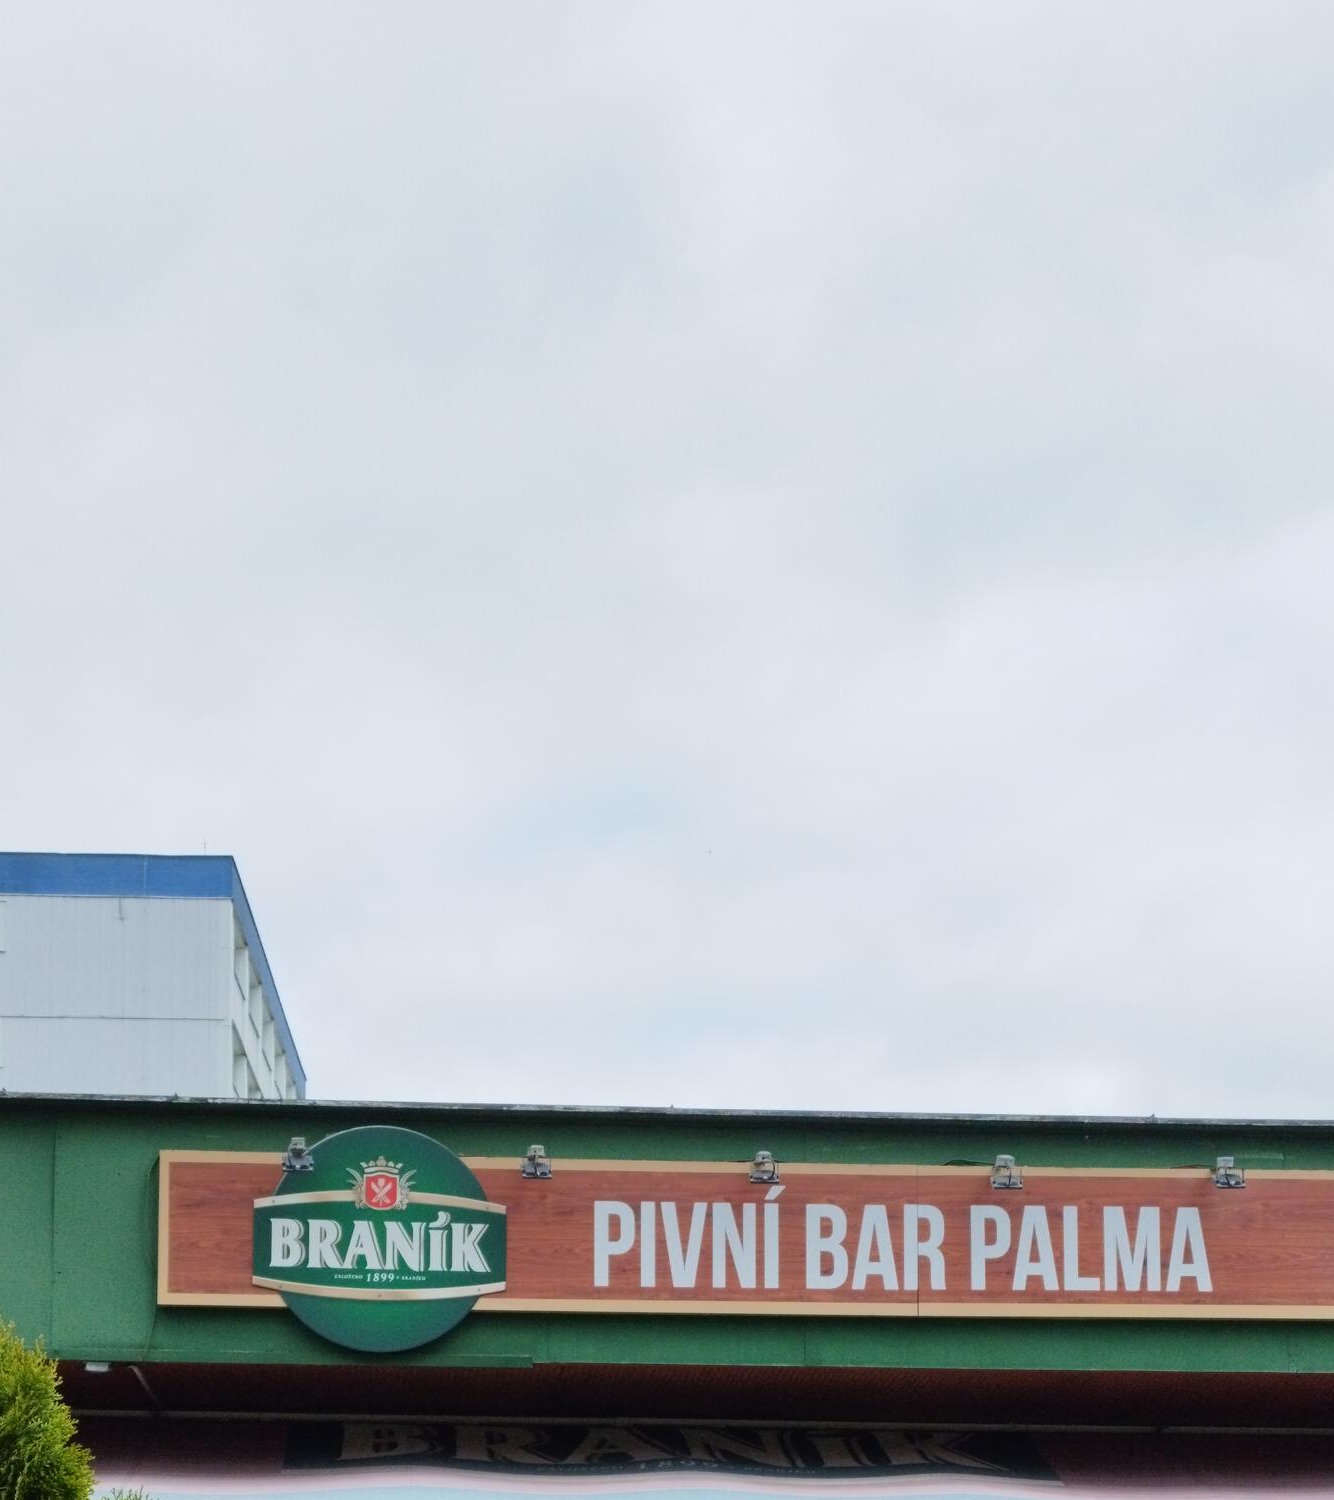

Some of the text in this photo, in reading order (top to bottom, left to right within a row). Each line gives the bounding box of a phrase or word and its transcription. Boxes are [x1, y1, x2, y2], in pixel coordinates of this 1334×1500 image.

[269, 1211, 491, 1273] BRANÍK
[593, 1184, 1213, 1292] PIVNÍ BAR PALMA
[366, 1272, 395, 1282] 1899
